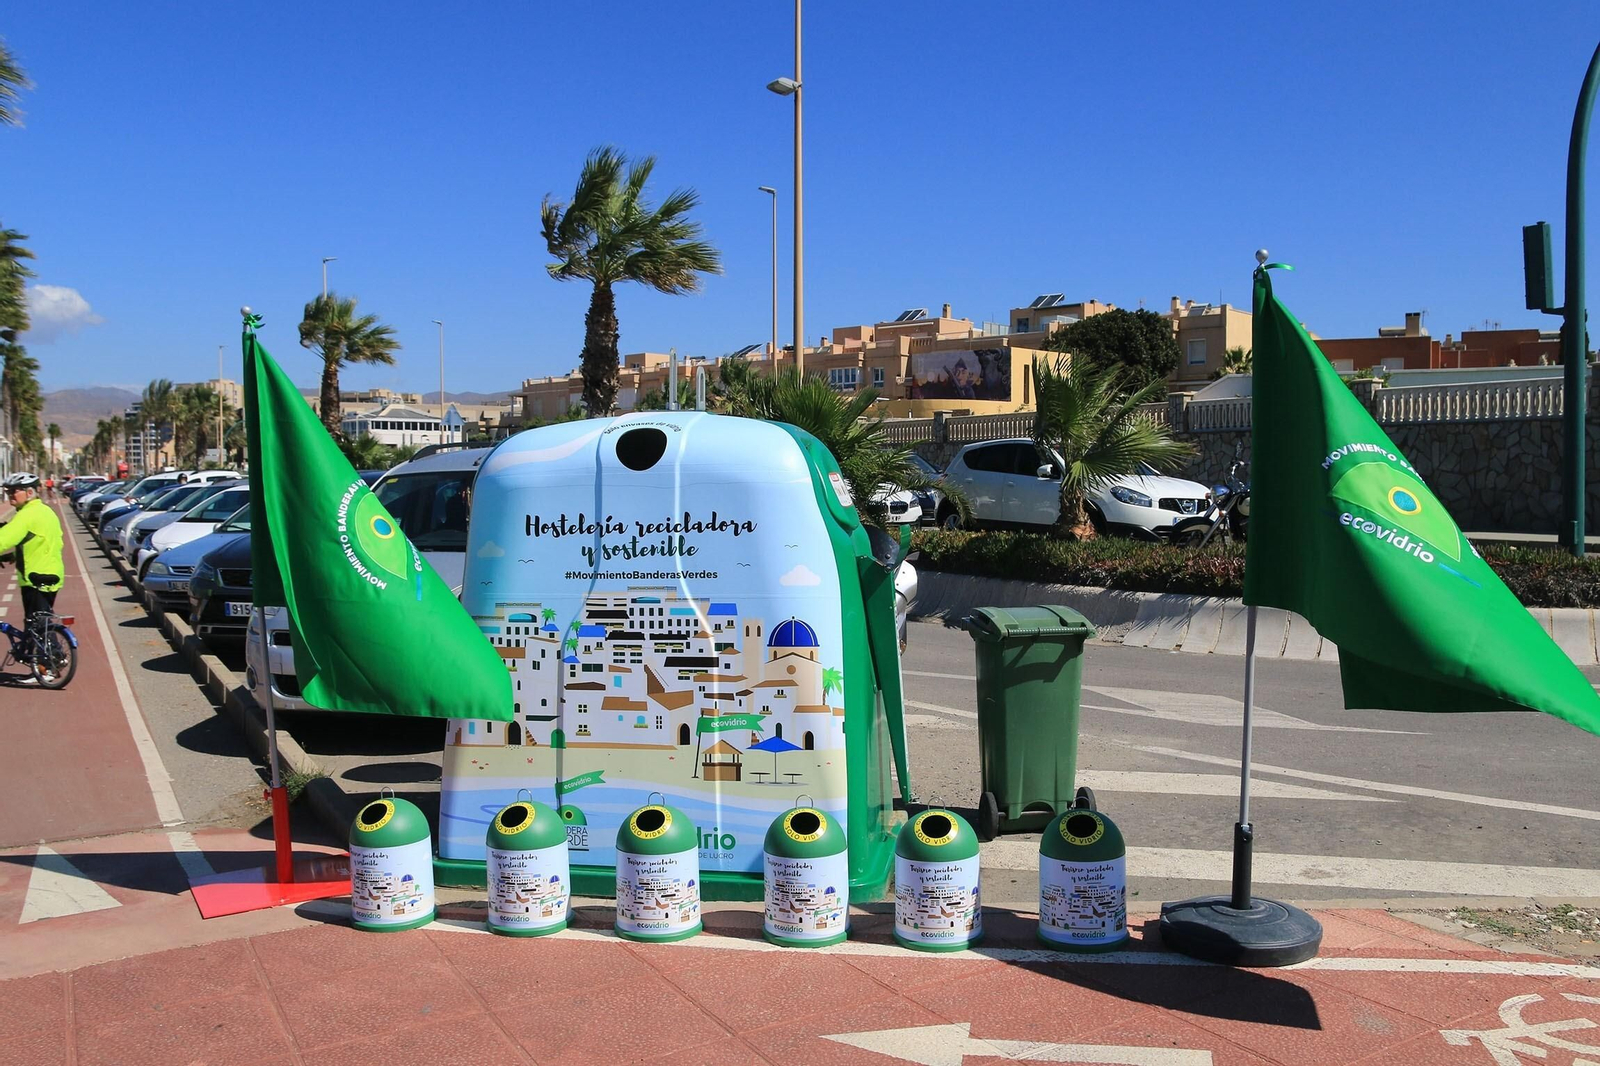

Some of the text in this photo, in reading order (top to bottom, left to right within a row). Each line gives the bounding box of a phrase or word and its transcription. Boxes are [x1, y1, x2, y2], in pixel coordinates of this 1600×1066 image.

[1321, 443, 1397, 470] MOVIMIENTO
[337, 483, 359, 532] BANDERAS
[525, 511, 758, 538] Hostelería recicladora
[1339, 512, 1434, 563] ecovidrio
[581, 535, 699, 567] y sostenible
[340, 535, 388, 590] MOVIMIENTO
[565, 570, 718, 580] #MovimientoBanderasVerdes
[710, 718, 747, 728] ecovidrio
[564, 777, 592, 789] ecovidrio
[503, 822, 528, 834] VIDRIO
[785, 825, 801, 841] SOLO
[1061, 828, 1103, 844] SOLO VIDRIO
[916, 829, 931, 844] SOLO
[500, 915, 530, 923] ecovidrio
[774, 923, 804, 933] ecovidrio
